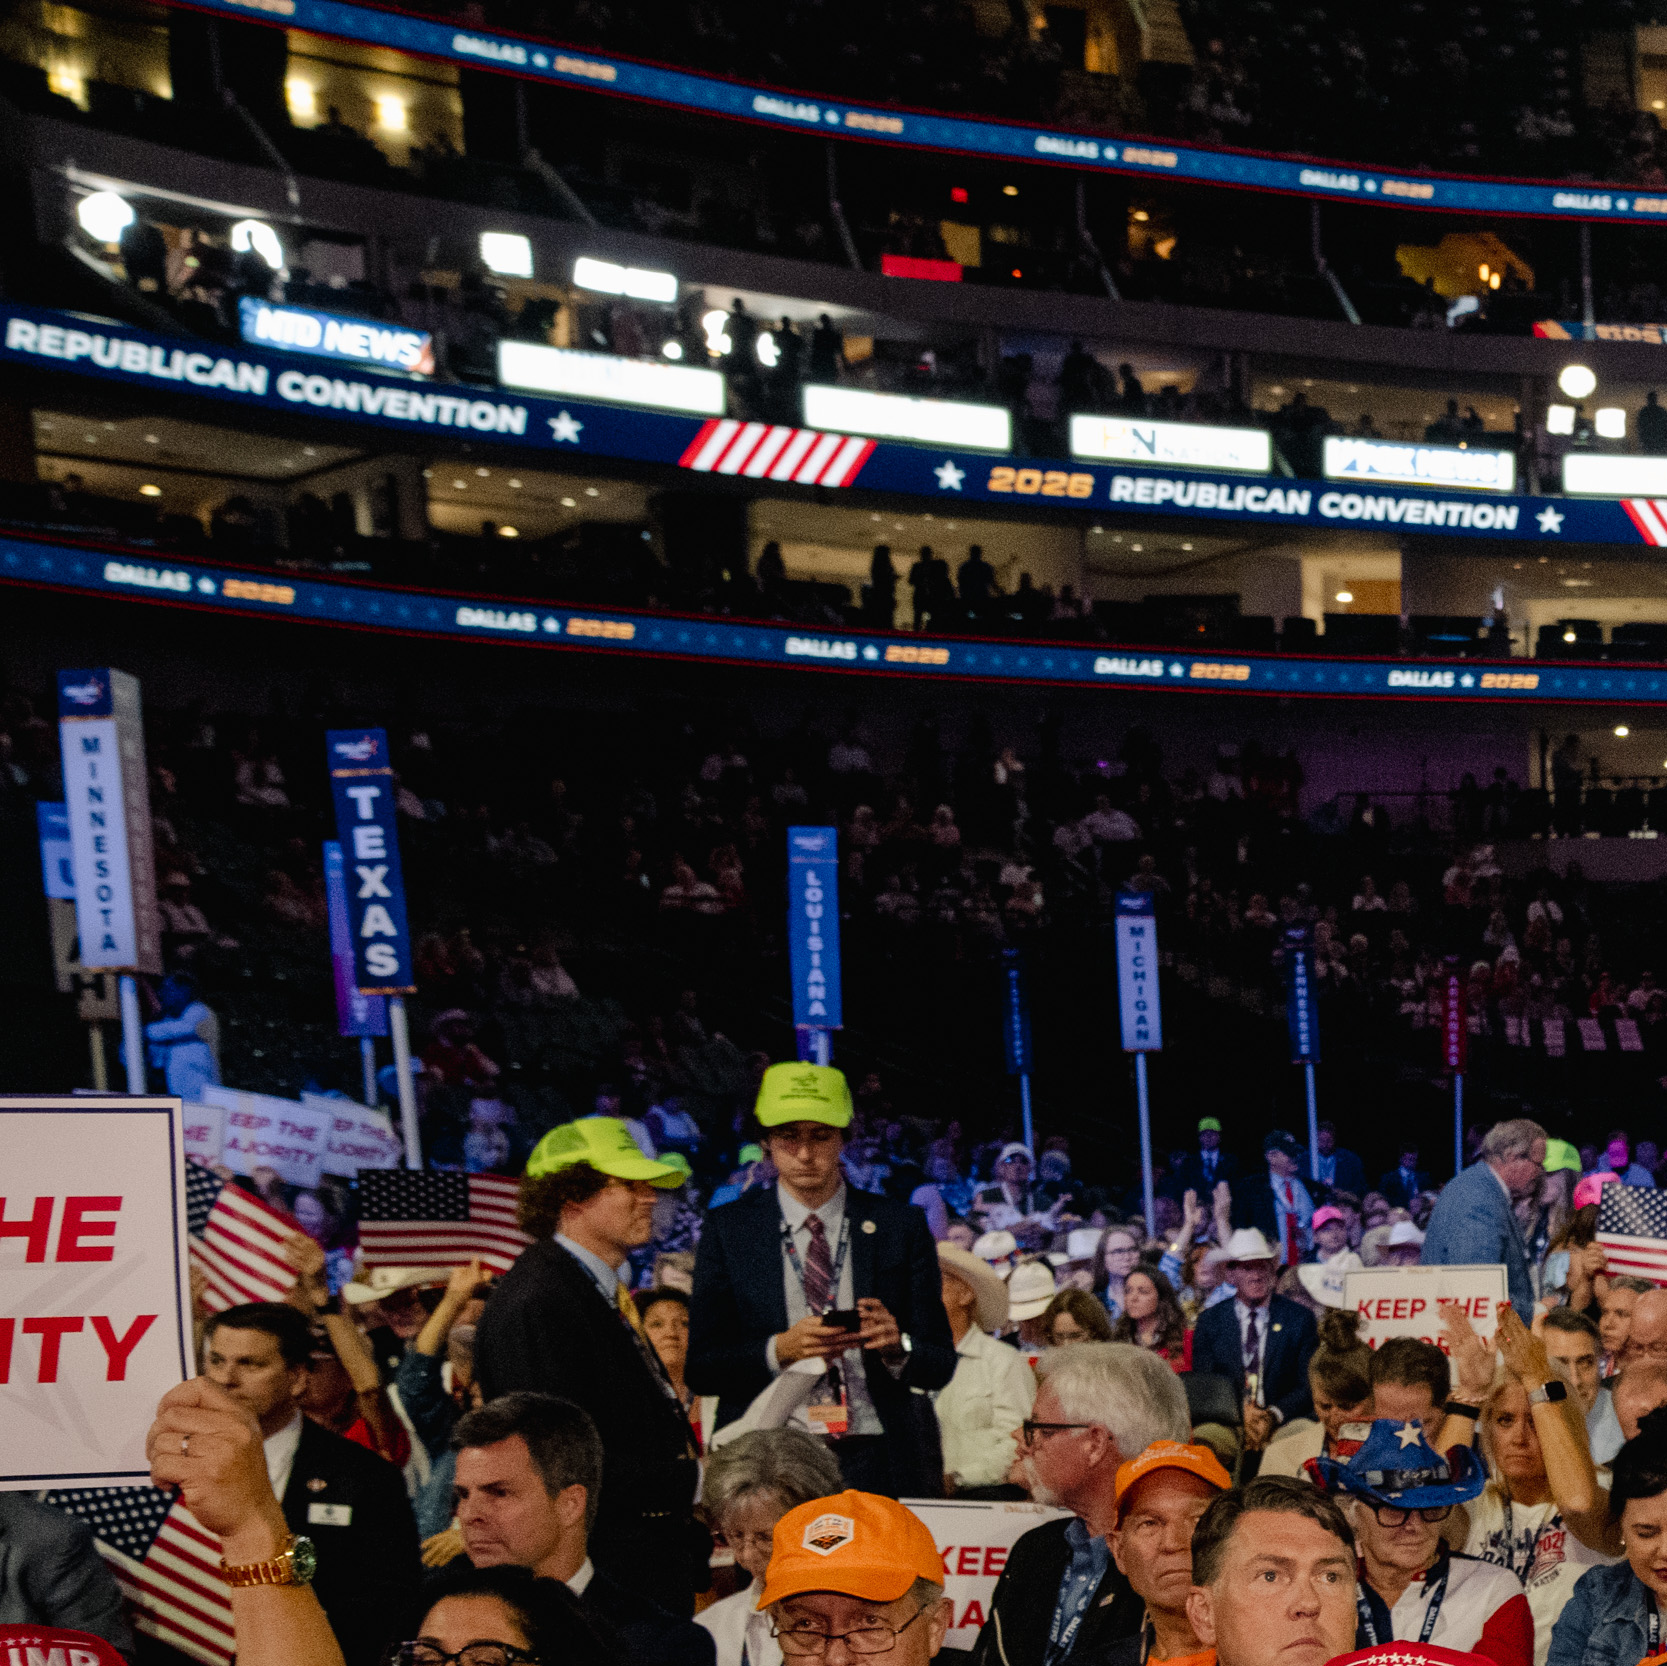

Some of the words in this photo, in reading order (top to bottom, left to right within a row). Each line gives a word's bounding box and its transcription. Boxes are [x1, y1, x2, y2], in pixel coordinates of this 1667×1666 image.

[7, 311, 272, 394] REPUBLICAN
[278, 355, 534, 433] CONVENTION
[325, 320, 421, 366] NEWS
[105, 563, 190, 591] DALLAS
[81, 736, 119, 951] MINNESOTA
[347, 785, 400, 978] TEXAS
[805, 869, 828, 1018] LOUISIANA
[1129, 926, 1150, 1042] MICHIGAN
[1294, 951, 1310, 1056] TENNESSEE
[274, 1118, 322, 1142] THE
[1356, 1297, 1428, 1320] KEEP
